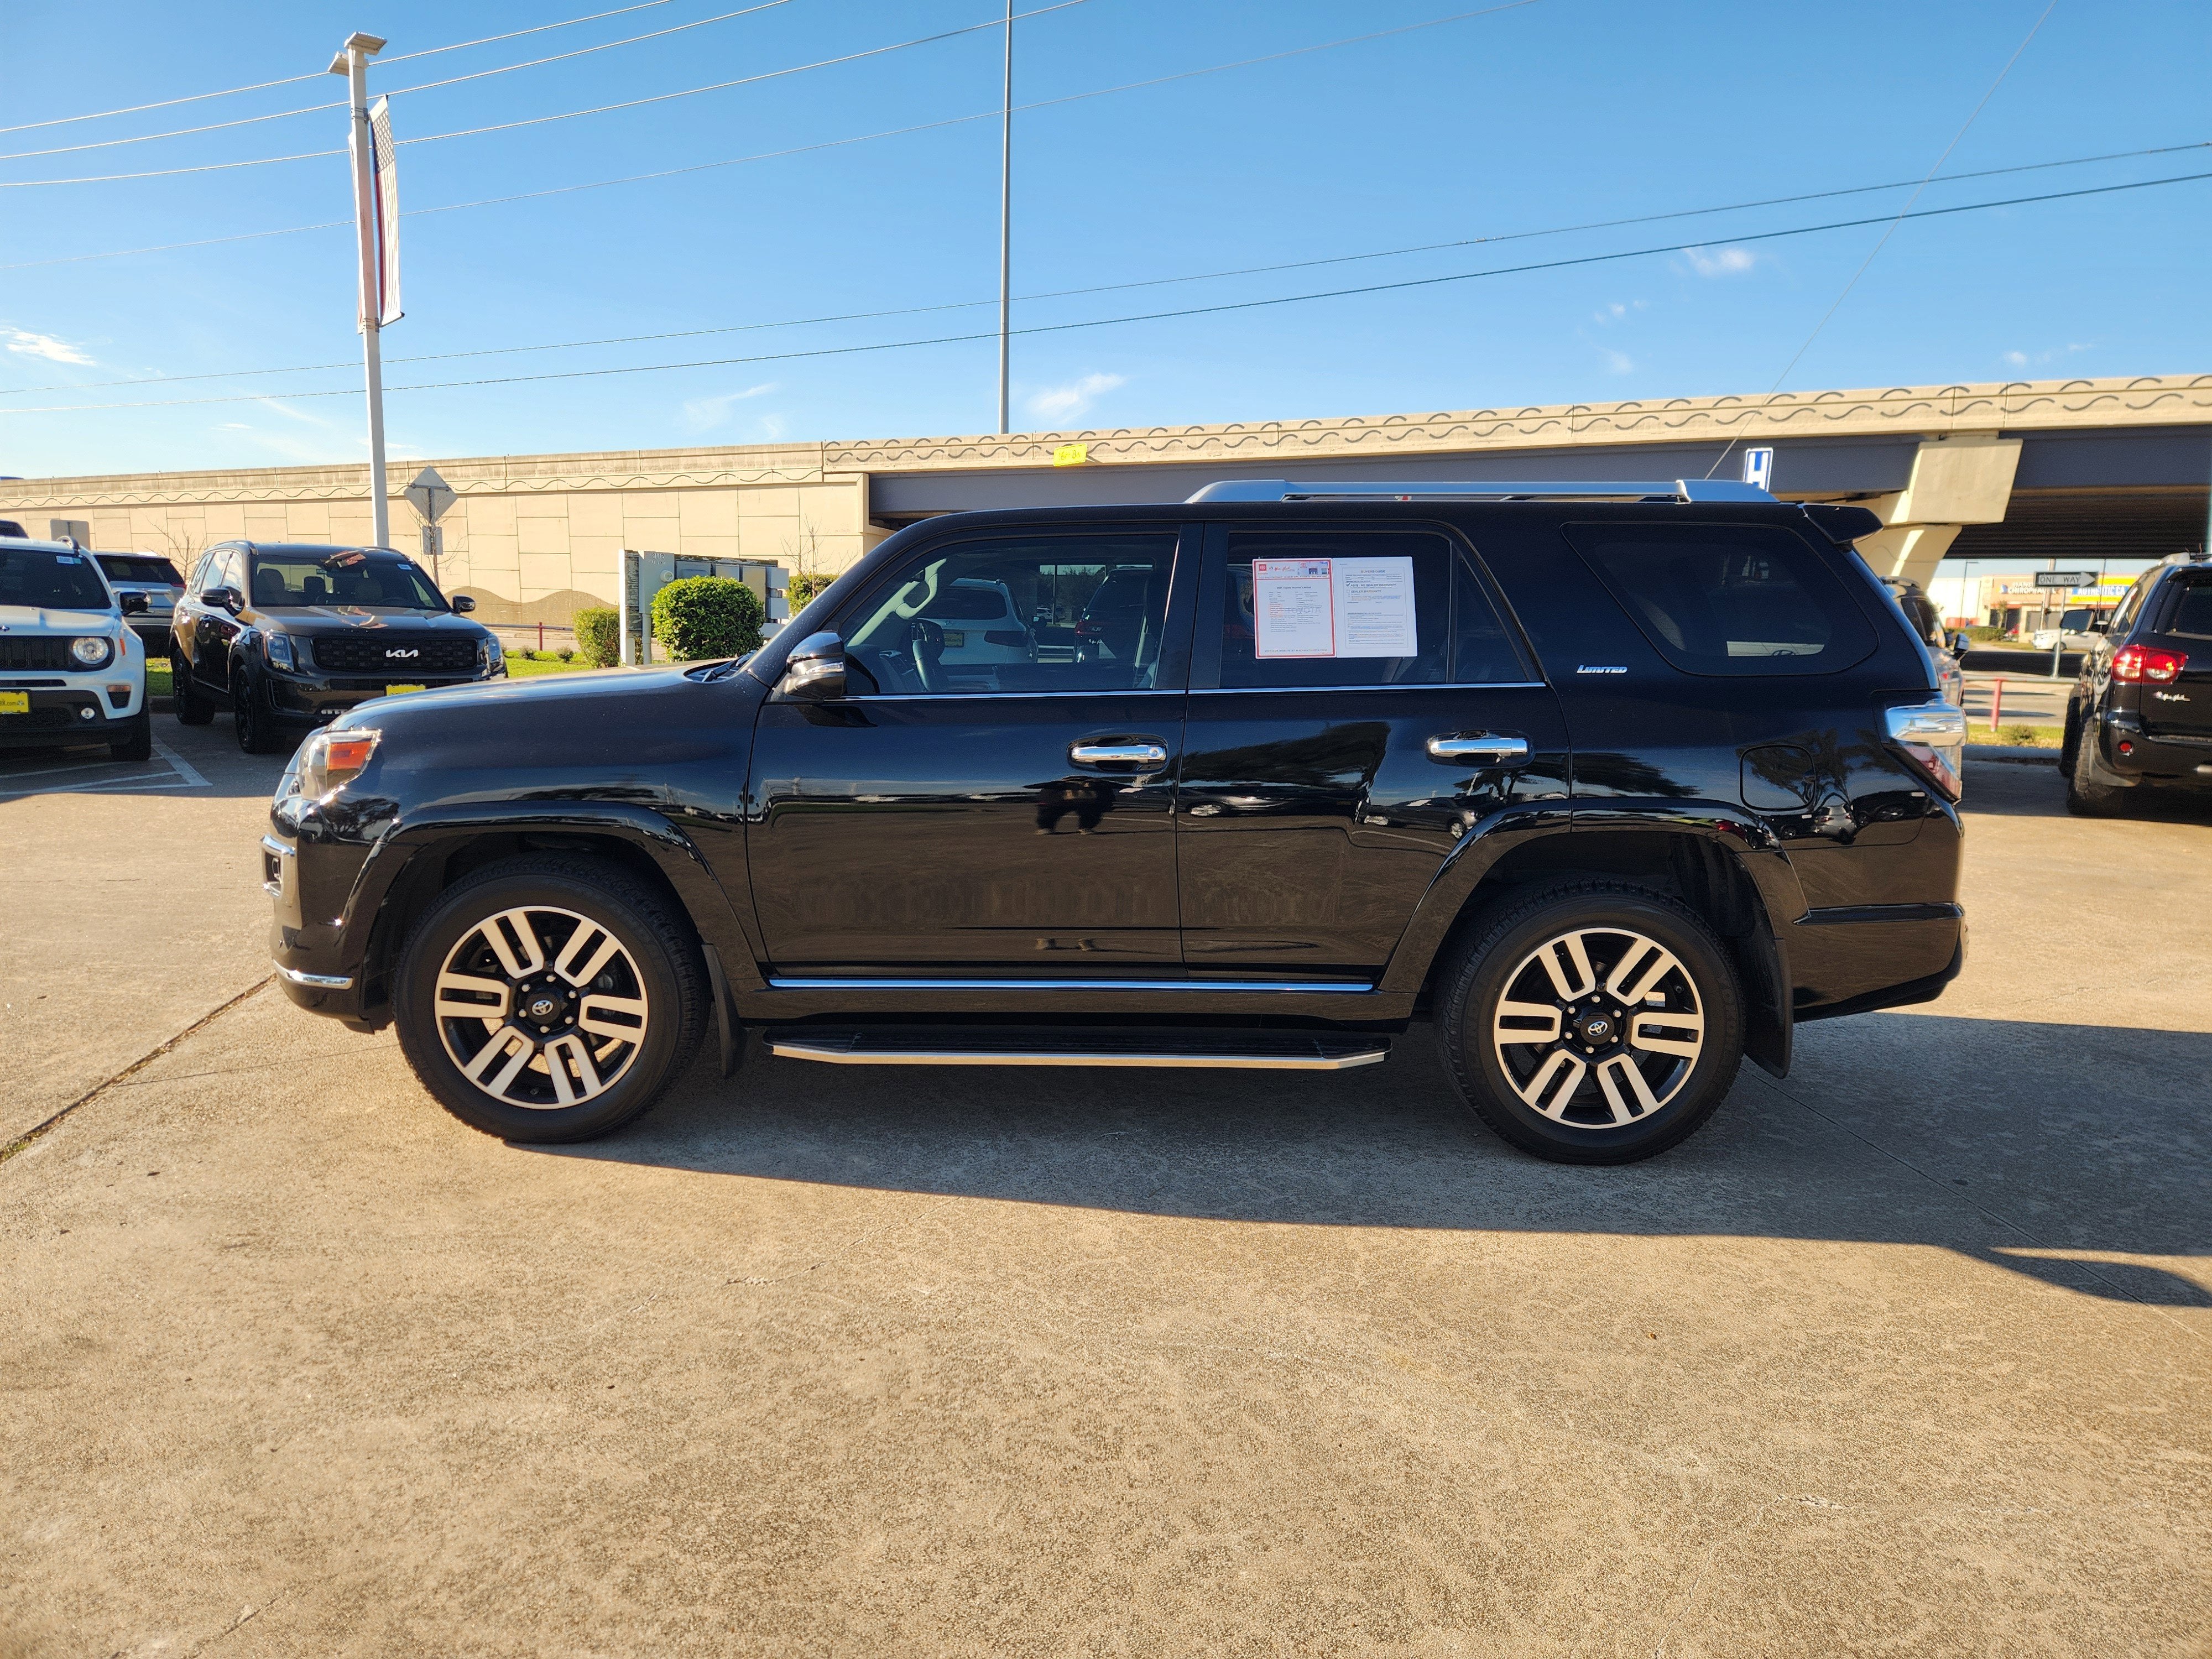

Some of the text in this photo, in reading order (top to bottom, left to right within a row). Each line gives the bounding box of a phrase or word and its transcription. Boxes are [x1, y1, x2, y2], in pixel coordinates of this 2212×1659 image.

[1746, 452, 1769, 490] H
[385, 649, 419, 658] KIA
[1576, 665, 1627, 674] LIMITED
